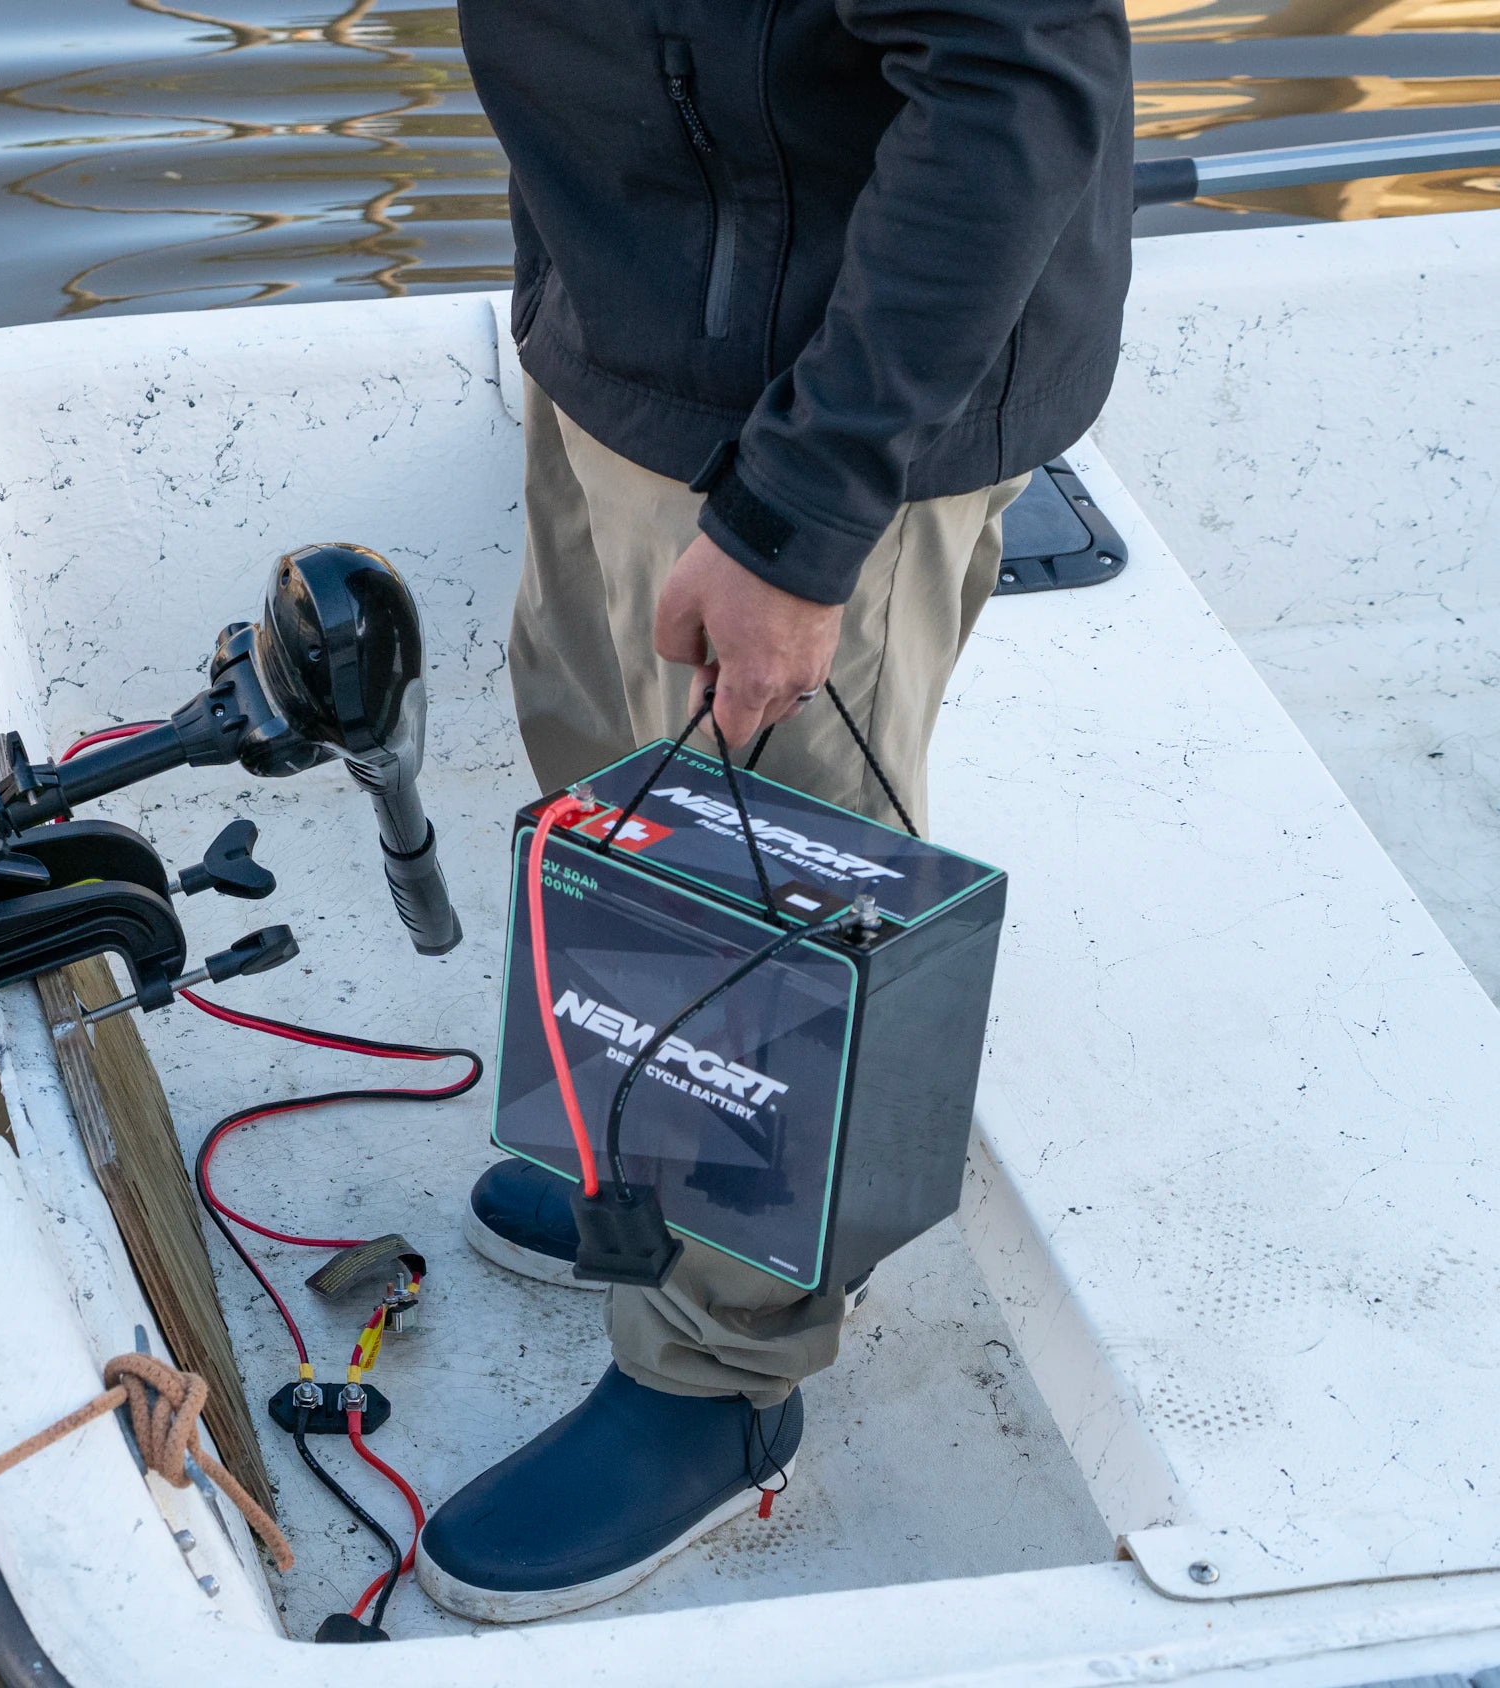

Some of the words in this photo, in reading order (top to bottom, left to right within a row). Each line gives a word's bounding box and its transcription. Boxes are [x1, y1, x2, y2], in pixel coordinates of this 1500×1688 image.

[662, 749, 688, 761] 1V
[687, 760, 724, 777] 50Ah
[649, 786, 905, 879] NEWPORT
[694, 818, 738, 839] DEEP
[735, 834, 786, 858] CCLE
[782, 851, 853, 881] BATTERY
[541, 859, 560, 874] 2V
[563, 866, 599, 891] 50Ah
[552, 989, 789, 1106] NEWPORT
[606, 1046, 635, 1068] DEE
[644, 1063, 689, 1093] CYCLE
[690, 1086, 758, 1121] BATTERY
